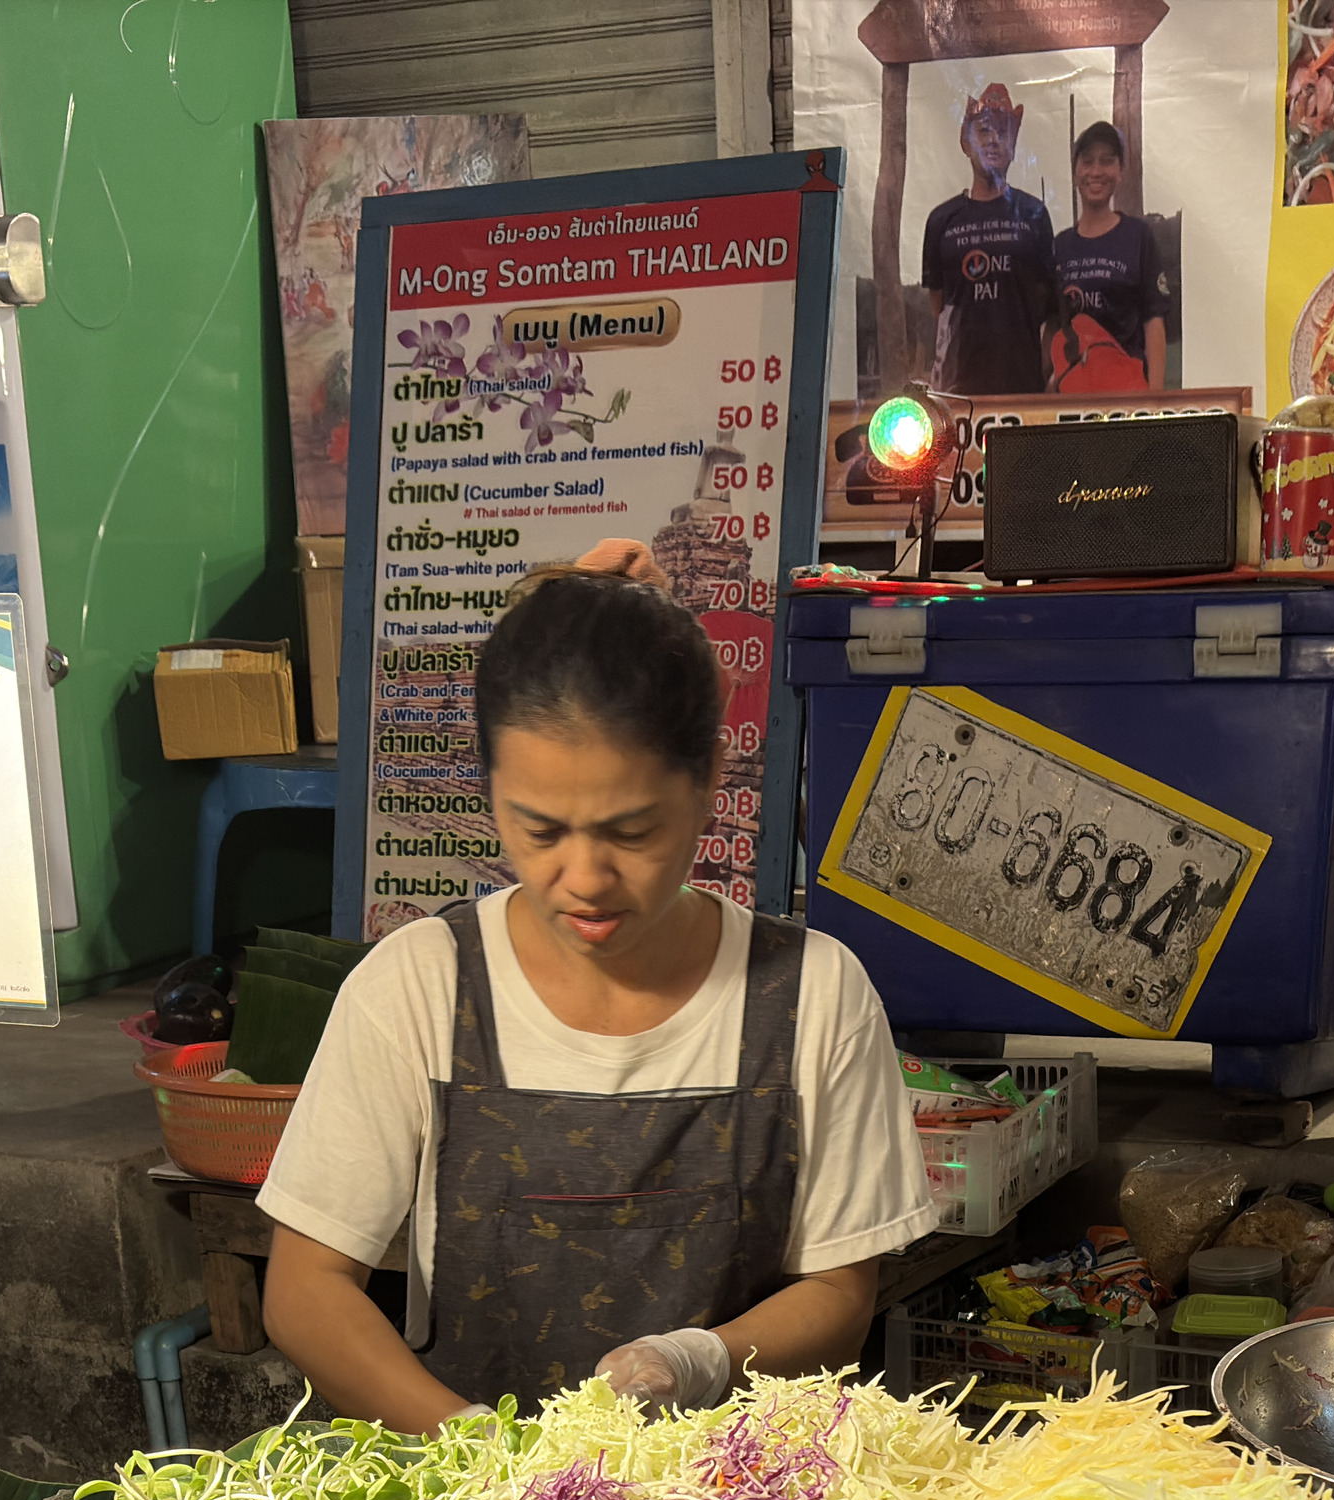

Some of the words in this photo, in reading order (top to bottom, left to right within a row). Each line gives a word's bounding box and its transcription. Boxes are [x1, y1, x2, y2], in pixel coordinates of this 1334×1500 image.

[487, 221, 562, 246] เอ็ม-ออง
[568, 207, 699, 240] ส้มตำไทยแลนด์
[398, 264, 487, 298] M-Ong
[498, 257, 616, 291] Somtam
[628, 236, 789, 279] THAILAND
[974, 280, 998, 301] PAI
[513, 316, 560, 348] เมนู
[569, 305, 666, 343] (Menu)
[720, 358, 755, 383] 50
[394, 374, 462, 403] ตำไทย
[468, 376, 504, 396] (Thai
[506, 373, 551, 393] salad)
[717, 406, 752, 431] 50
[391, 421, 409, 456] ปู
[414, 417, 483, 445] ปลาร้า
[391, 453, 448, 473] (Papaya
[451, 452, 489, 469] salad
[494, 450, 523, 467] with
[525, 448, 558, 465] crab
[561, 446, 587, 463] and
[591, 442, 667, 462] fermented
[670, 439, 704, 459] fish)
[388, 480, 459, 507] ตำแตง
[464, 481, 550, 503] (Cucumber
[553, 477, 604, 499] Salad)
[713, 467, 747, 491] 50
[502, 505, 530, 517] salad
[547, 502, 603, 516] fermented
[606, 501, 627, 513] fish
[387, 518, 519, 556] ตำซั่ว-หมูยอ
[712, 516, 745, 540] 70
[385, 563, 418, 579] (Tam
[423, 562, 492, 576] Sua-white
[496, 560, 526, 577] pork
[709, 582, 745, 608] 70
[384, 621, 418, 638] (Thai
[380, 683, 418, 699] (Crab
[422, 684, 448, 698] and
[394, 709, 433, 722] White
[378, 727, 449, 754] ตำแตง
[377, 763, 451, 780] (Cucumber
[375, 831, 501, 858] ตำผลไม้รวม
[374, 871, 468, 897] ตำมะม่วง
